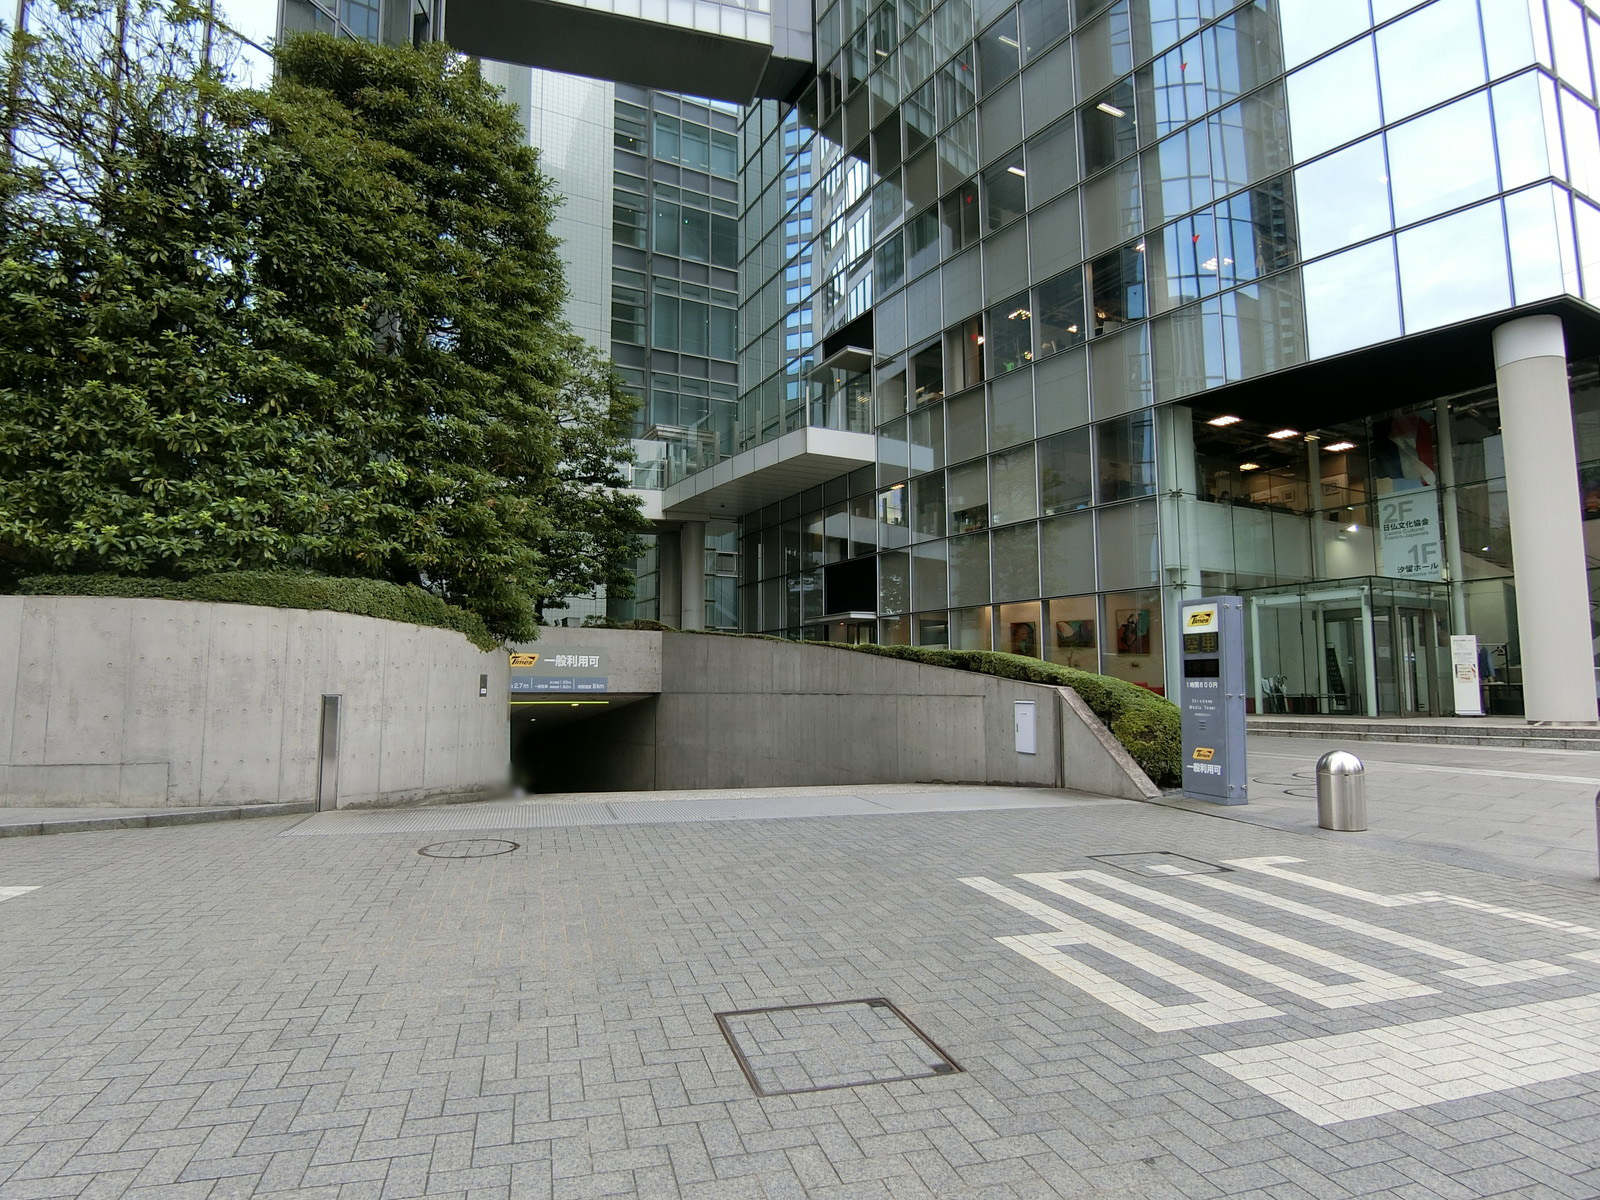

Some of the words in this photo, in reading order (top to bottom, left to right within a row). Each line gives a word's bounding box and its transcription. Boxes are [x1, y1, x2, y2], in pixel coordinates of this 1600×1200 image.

[1383, 500, 1413, 524] 2F
[1383, 517, 1429, 532] 日仏文化協会
[1408, 542, 1437, 565] 1F
[1397, 562, 1439, 573] 汐留ホール
[511, 656, 534, 666] Times
[544, 655, 600, 667] 一般利用可
[1186, 681, 1218, 689] 1時間800円
[1187, 762, 1221, 775] 一般利用可
